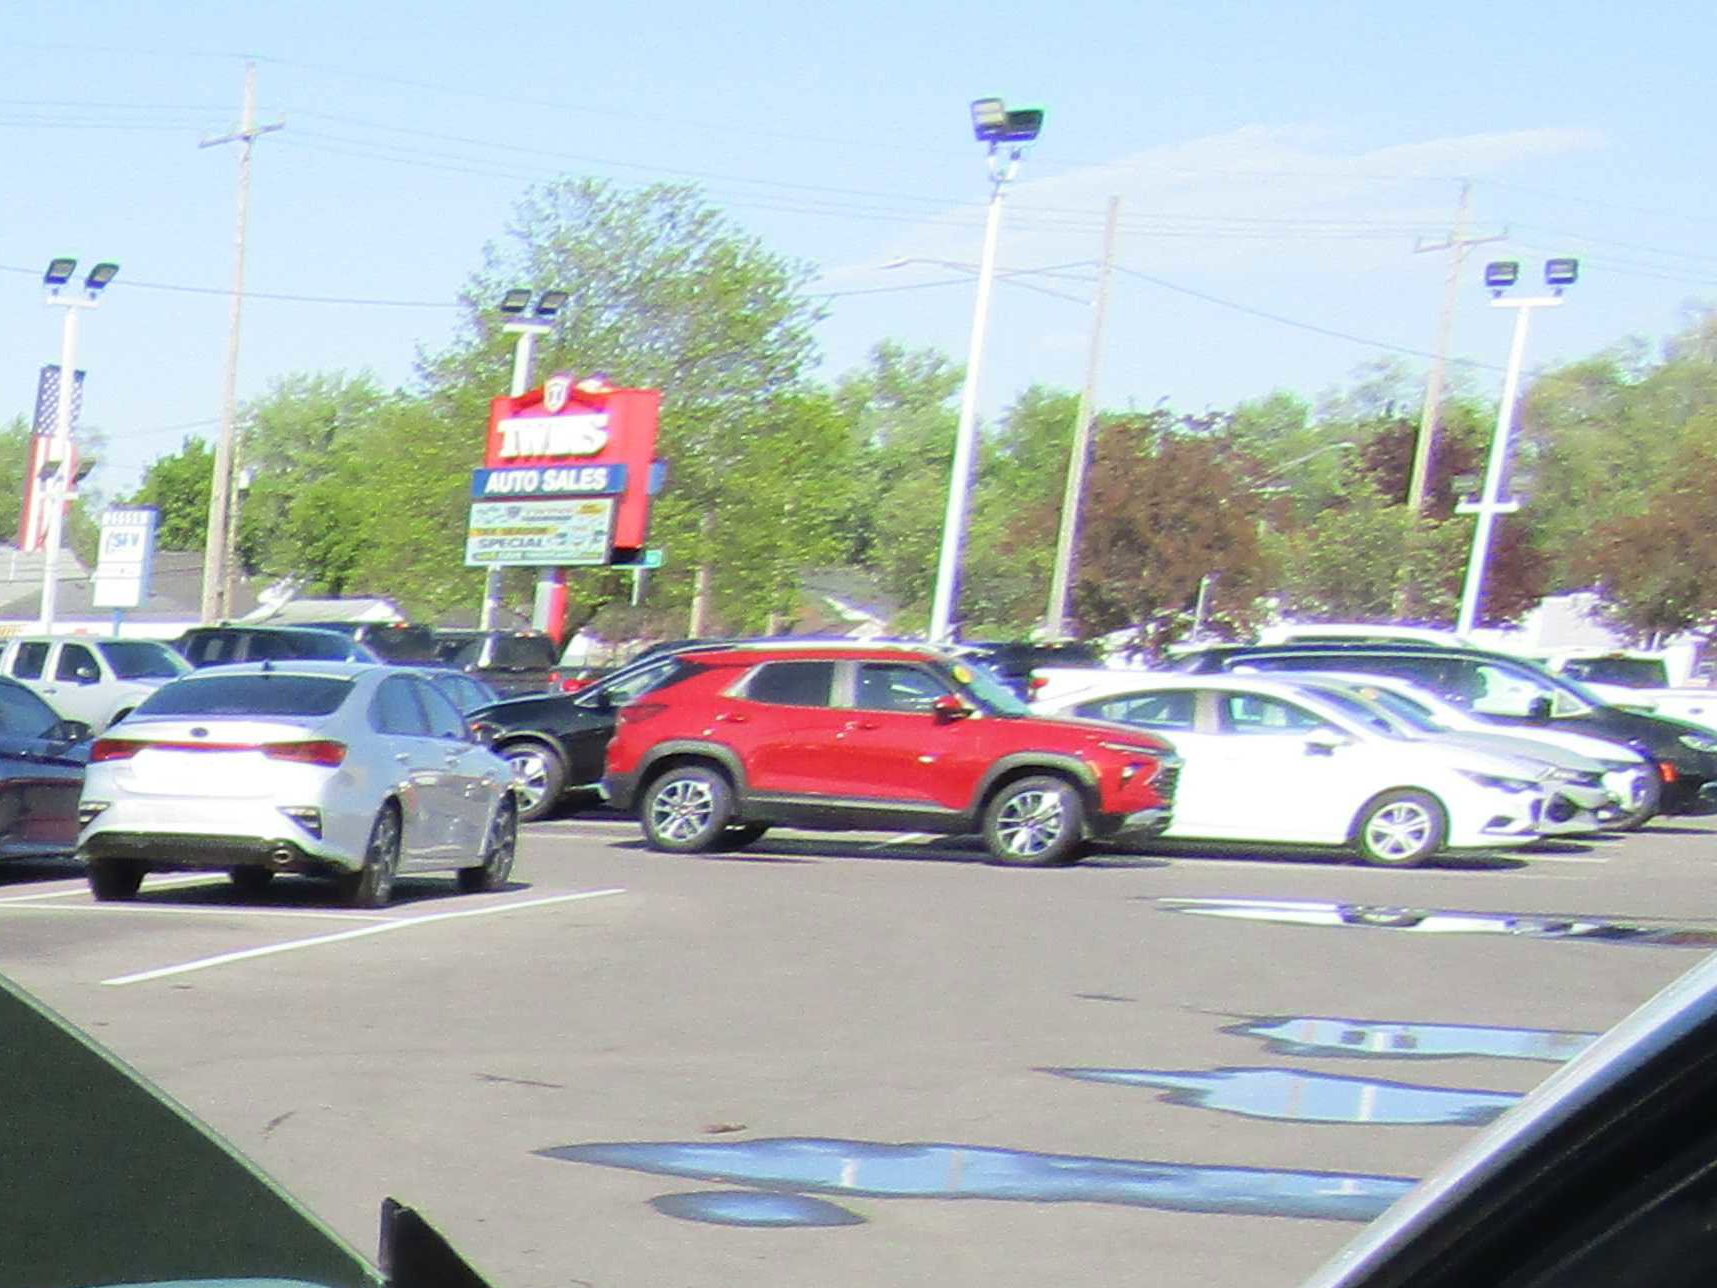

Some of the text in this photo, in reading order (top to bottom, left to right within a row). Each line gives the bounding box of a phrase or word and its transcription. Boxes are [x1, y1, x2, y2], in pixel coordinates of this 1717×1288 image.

[484, 466, 609, 494] AUTO SALES
[478, 537, 544, 549] SPECIAL
